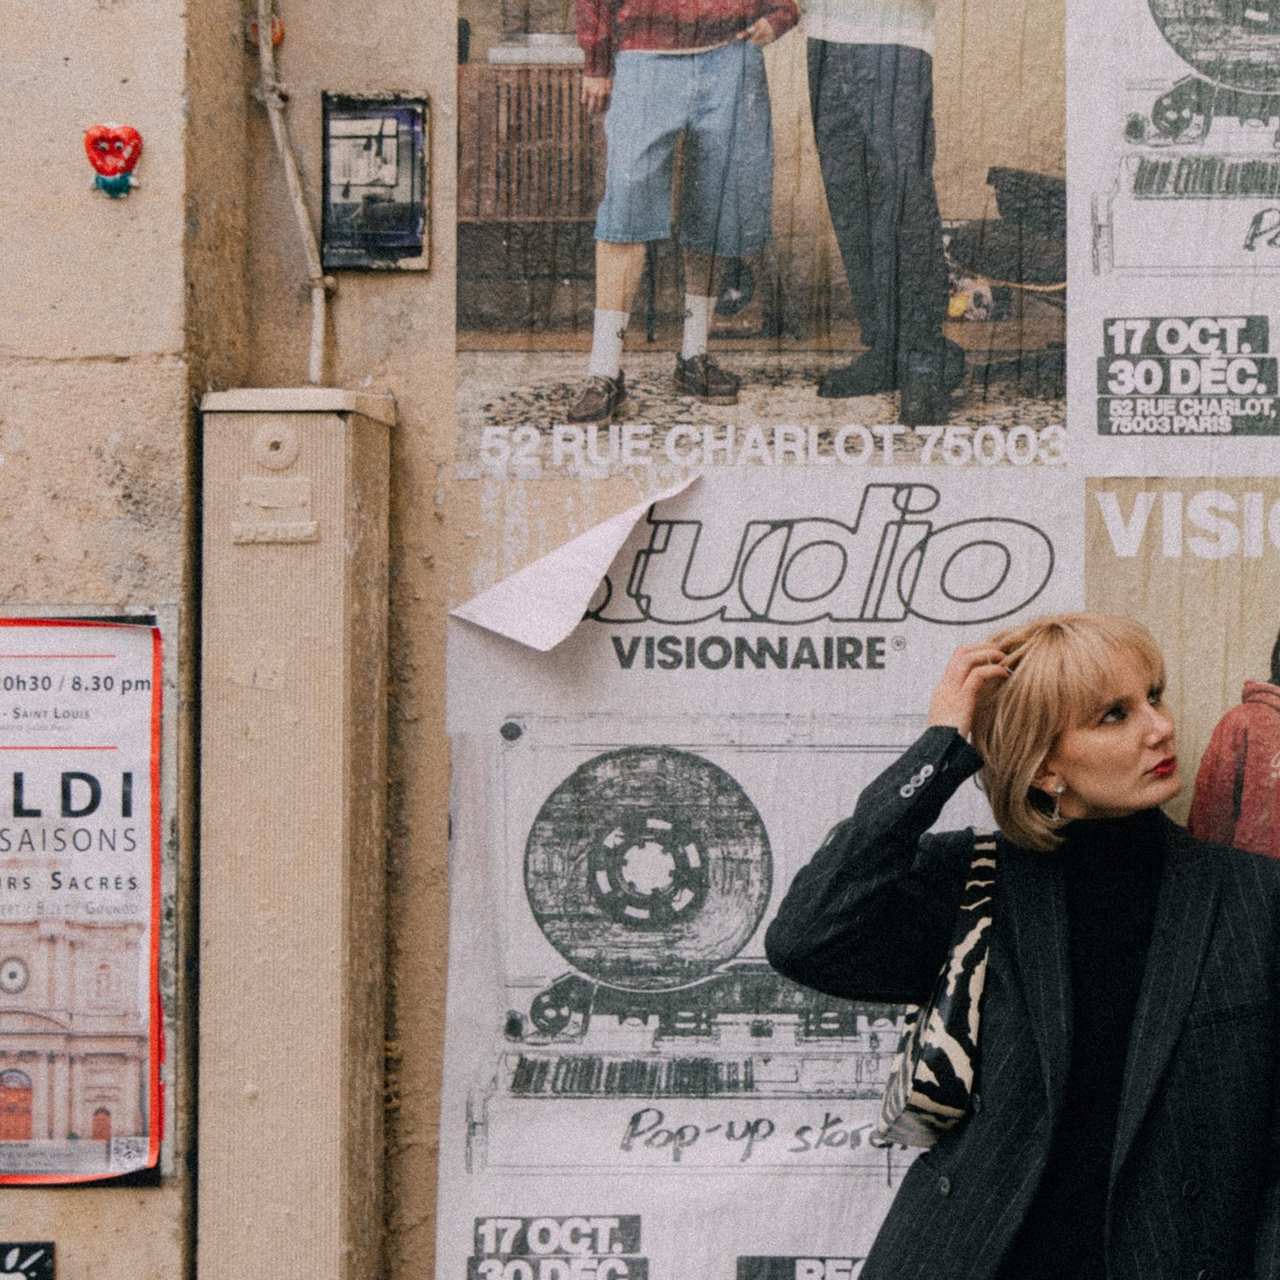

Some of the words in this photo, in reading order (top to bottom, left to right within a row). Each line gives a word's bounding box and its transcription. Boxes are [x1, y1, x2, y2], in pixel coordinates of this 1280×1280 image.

[1107, 319, 1151, 355] 17
[1155, 317, 1252, 355] OCT.
[1107, 358, 1163, 395] 30
[1109, 398, 1134, 417] 52
[1135, 398, 1177, 417] RUE
[1179, 398, 1277, 419] CHARLOT,
[1109, 416, 1171, 434] 75003
[1173, 416, 1233, 434] PARIS
[478, 423, 541, 468] 52
[552, 423, 653, 468] RUE
[664, 423, 906, 468] CHARLOT
[919, 422, 1069, 468] 75003
[582, 482, 1056, 626] tudio
[610, 636, 886, 670] VISIONNAIRE
[71, 675, 115, 692] 8.30
[121, 678, 151, 696] pm
[12, 771, 134, 818] LDI
[0, 827, 138, 853] SAISONS
[0, 876, 32, 891] RS
[620, 1107, 776, 1162] Pop-up
[477, 1218, 523, 1254] 17
[526, 1217, 624, 1255] OCT.
